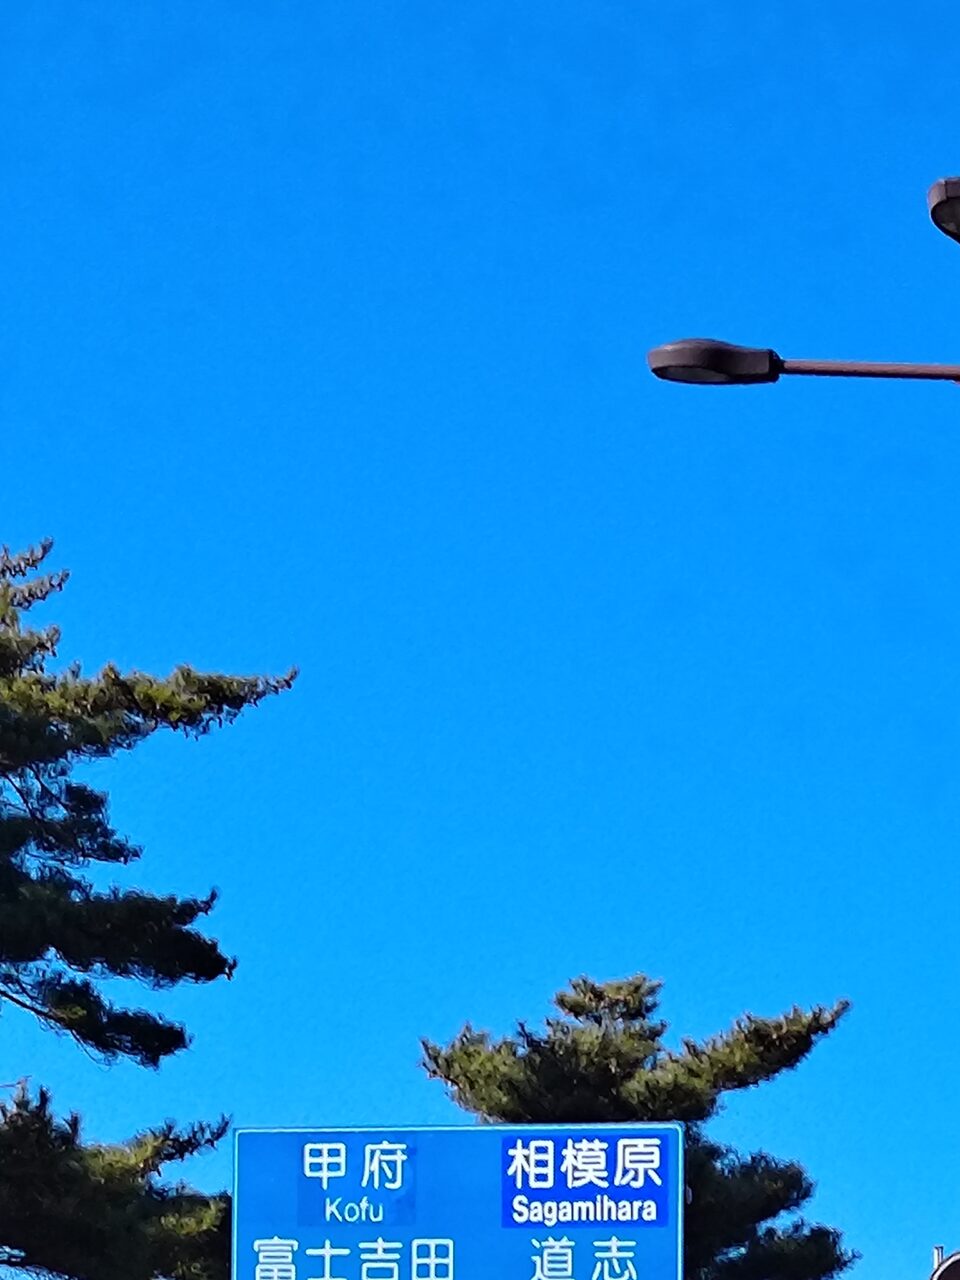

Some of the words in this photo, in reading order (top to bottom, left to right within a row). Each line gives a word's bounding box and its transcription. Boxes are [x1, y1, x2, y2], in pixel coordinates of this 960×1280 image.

[303, 1140, 408, 1190] 甲府
[506, 1137, 663, 1189] 相模原
[325, 1196, 384, 1222] Kofu
[512, 1194, 657, 1226] Sagamihara
